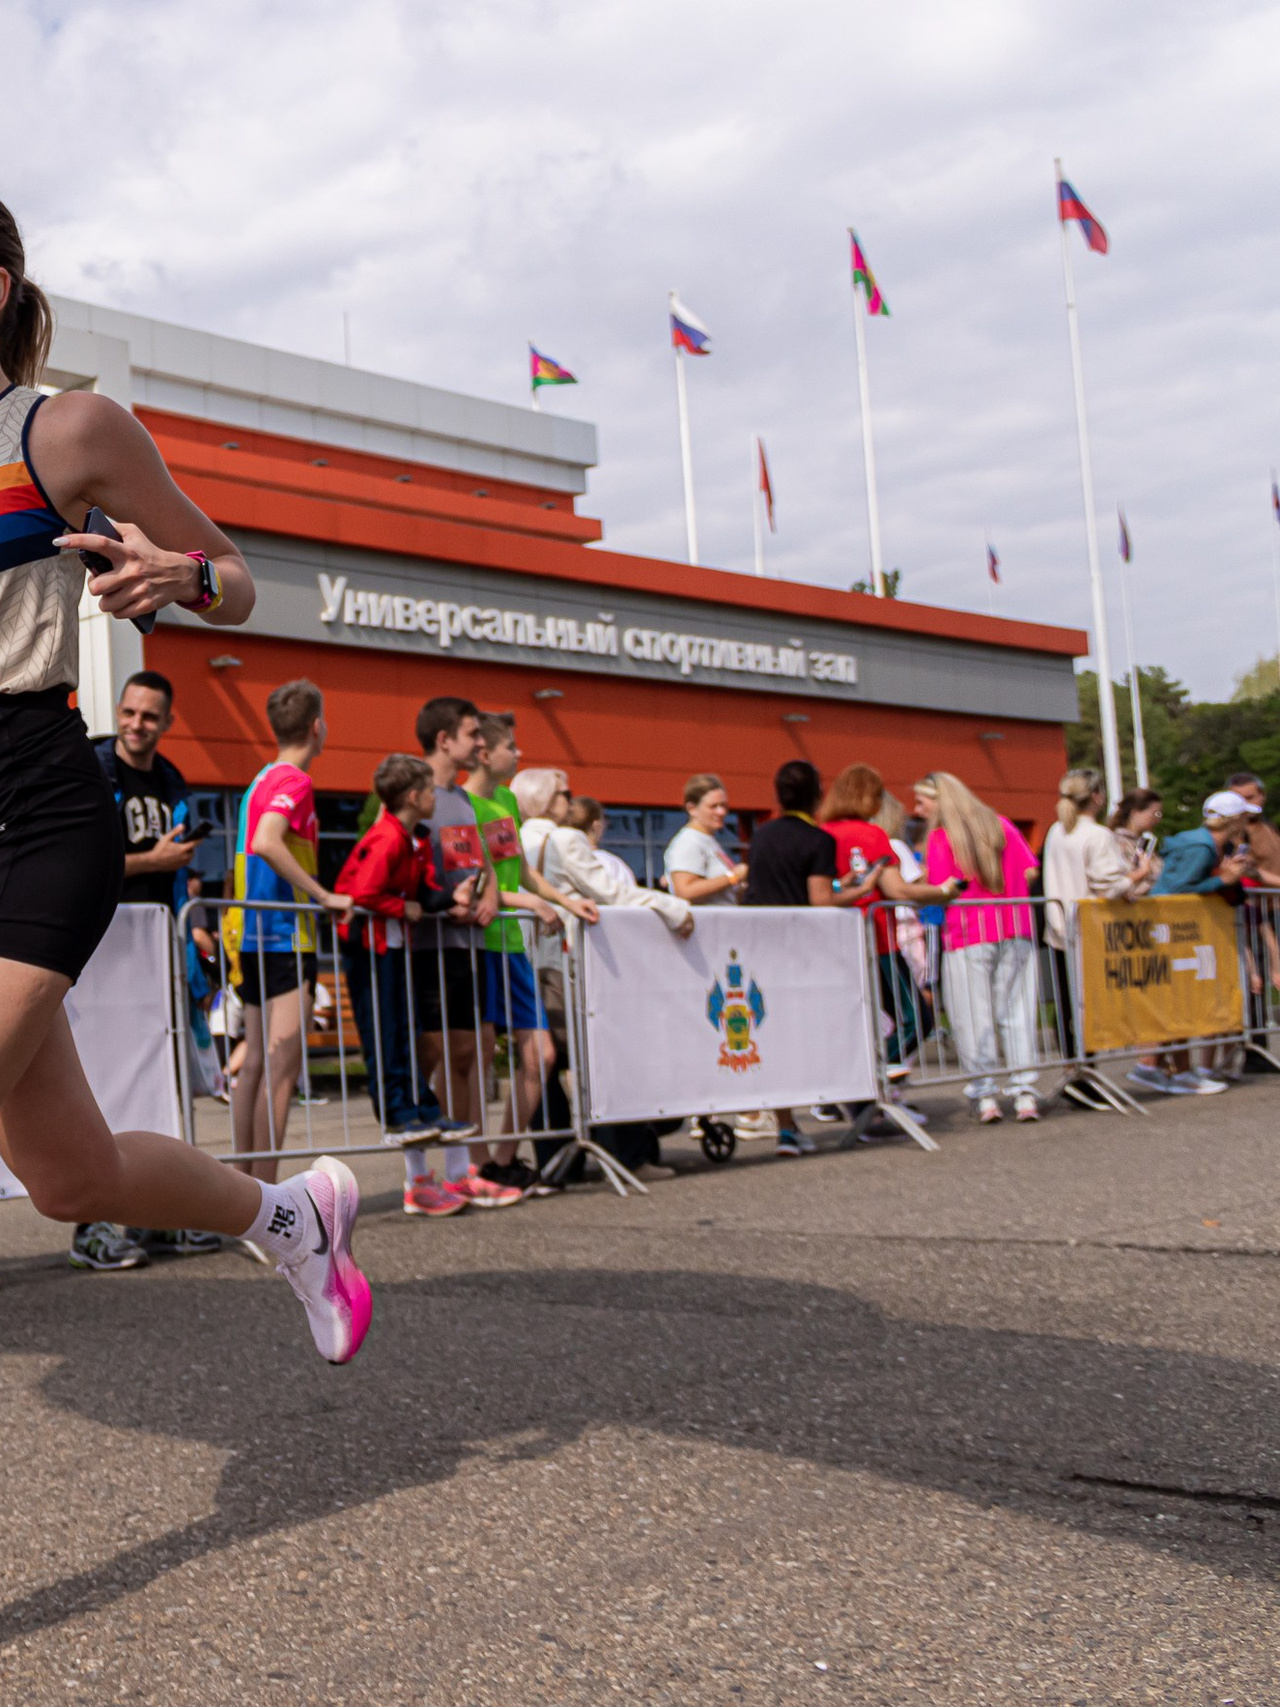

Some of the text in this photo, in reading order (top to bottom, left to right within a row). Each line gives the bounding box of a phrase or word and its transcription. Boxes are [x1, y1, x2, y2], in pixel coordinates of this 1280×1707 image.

[317, 572, 859, 685] Универсальный спортивный зал
